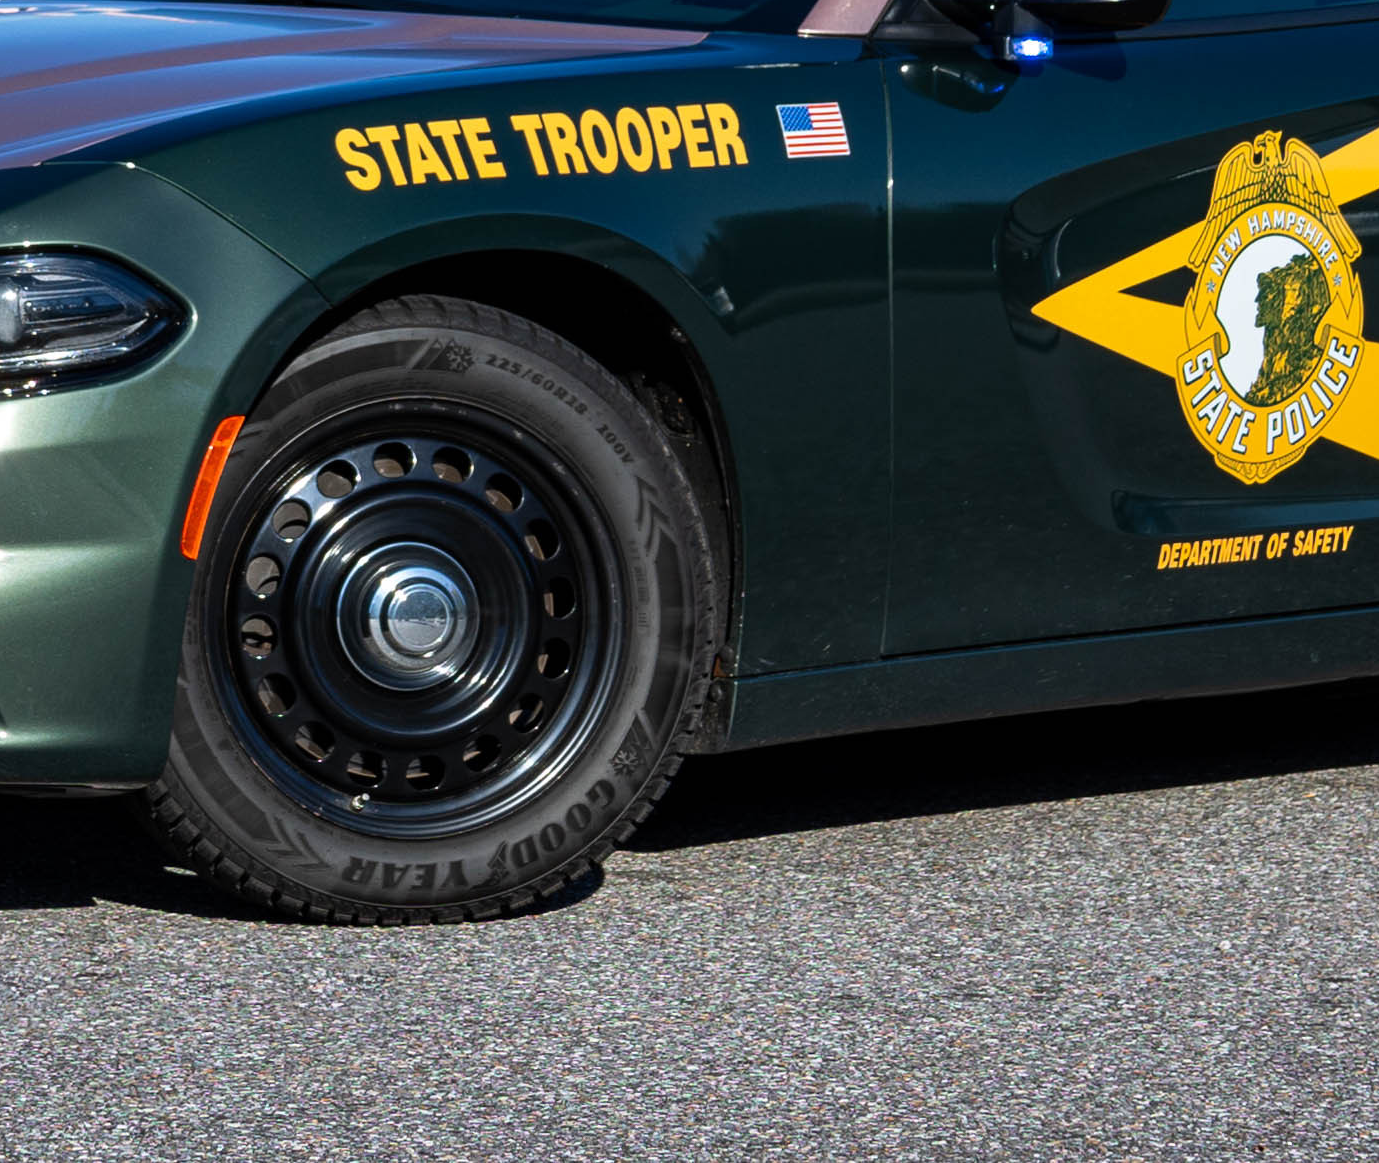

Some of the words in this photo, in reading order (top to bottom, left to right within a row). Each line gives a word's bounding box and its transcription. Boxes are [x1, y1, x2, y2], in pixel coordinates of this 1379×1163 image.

[334, 116, 507, 191] STATE
[510, 102, 749, 176] TROOPER
[1209, 226, 1243, 277] NEW
[1247, 209, 1339, 271] HAMPSHIRE
[1182, 348, 1256, 455] STATE
[1265, 337, 1360, 455] POLICE
[1156, 534, 1264, 570] DEPARTMENT
[1266, 532, 1290, 560] OF
[1292, 525, 1355, 557] SAFETY
